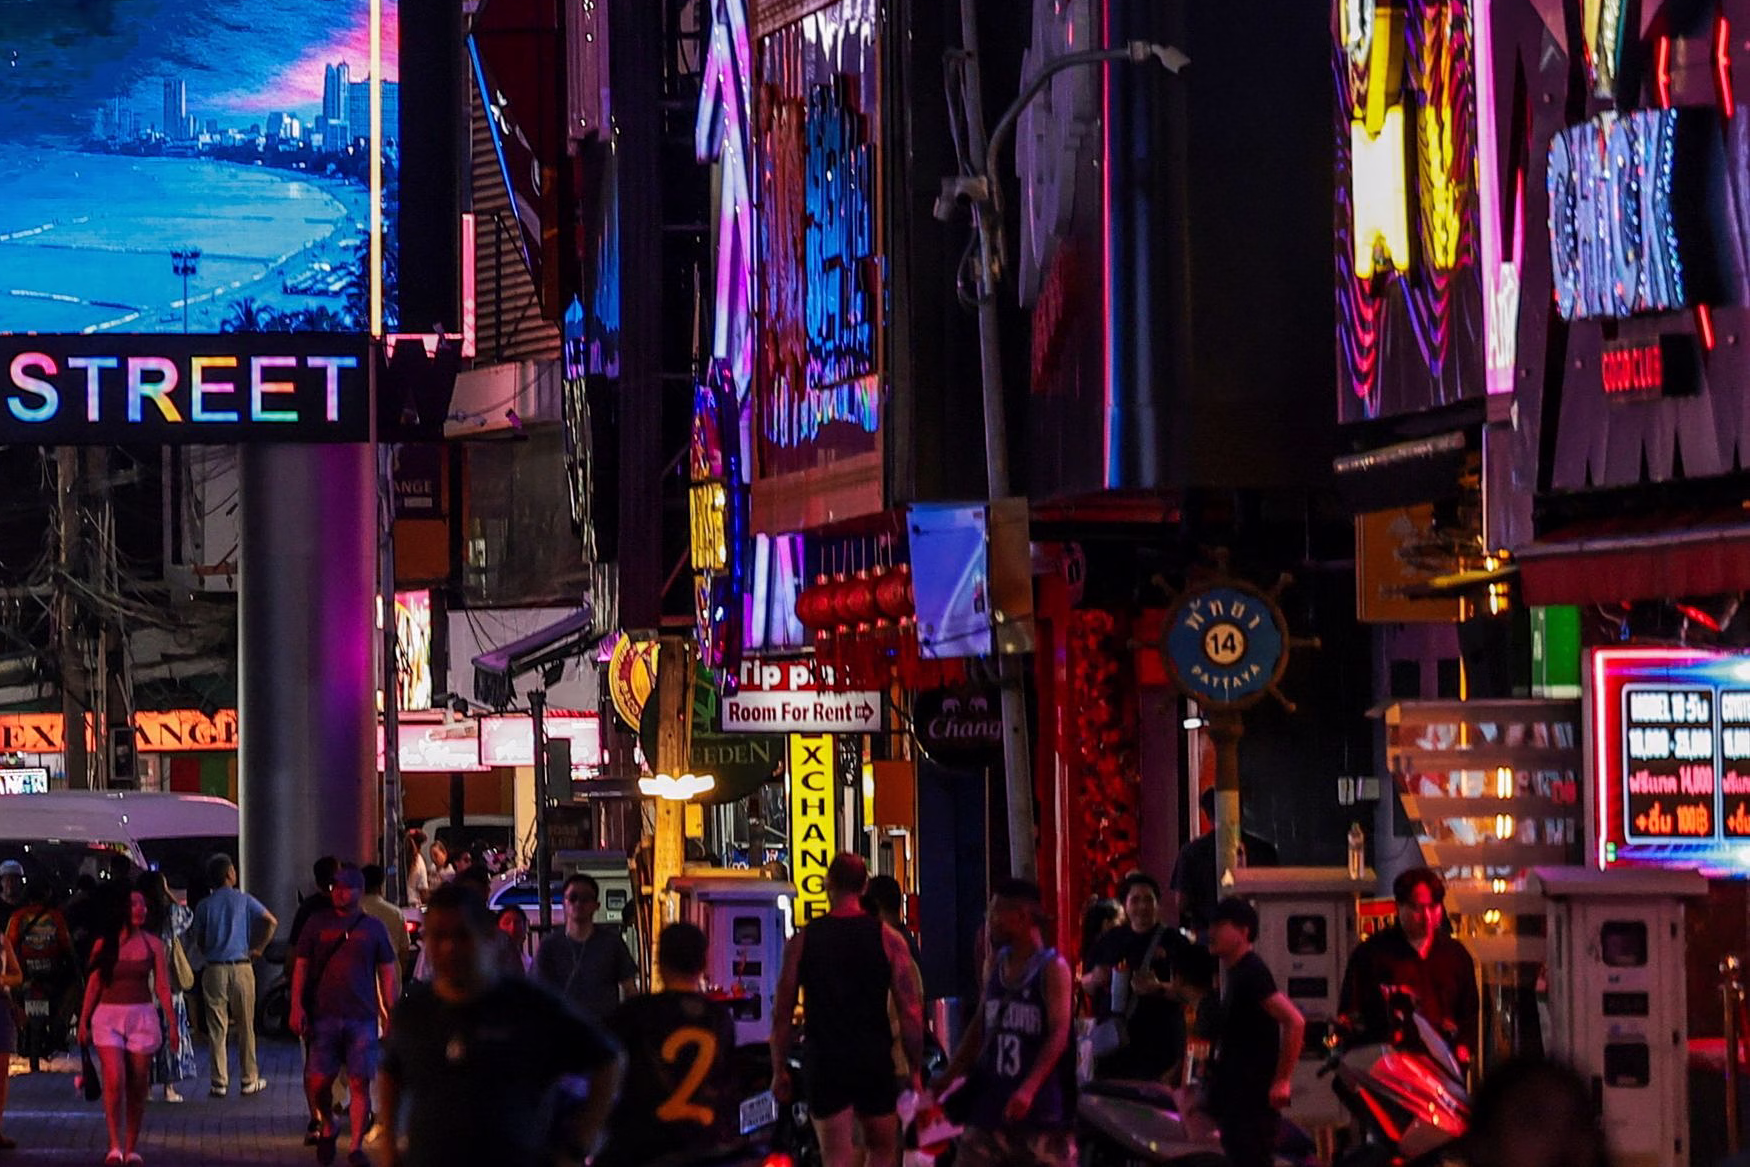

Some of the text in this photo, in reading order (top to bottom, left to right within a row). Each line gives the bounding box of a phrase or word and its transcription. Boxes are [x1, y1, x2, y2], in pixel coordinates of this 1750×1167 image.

[6, 351, 359, 422] STREET
[1209, 632, 1237, 656] 14
[1191, 664, 1261, 690] PATTAYA
[728, 701, 852, 722] Room For Rent
[929, 719, 1003, 740] Chang
[801, 734, 828, 911] XCHANGE
[996, 1033, 1021, 1079] 13
[655, 1025, 718, 1126] 2
